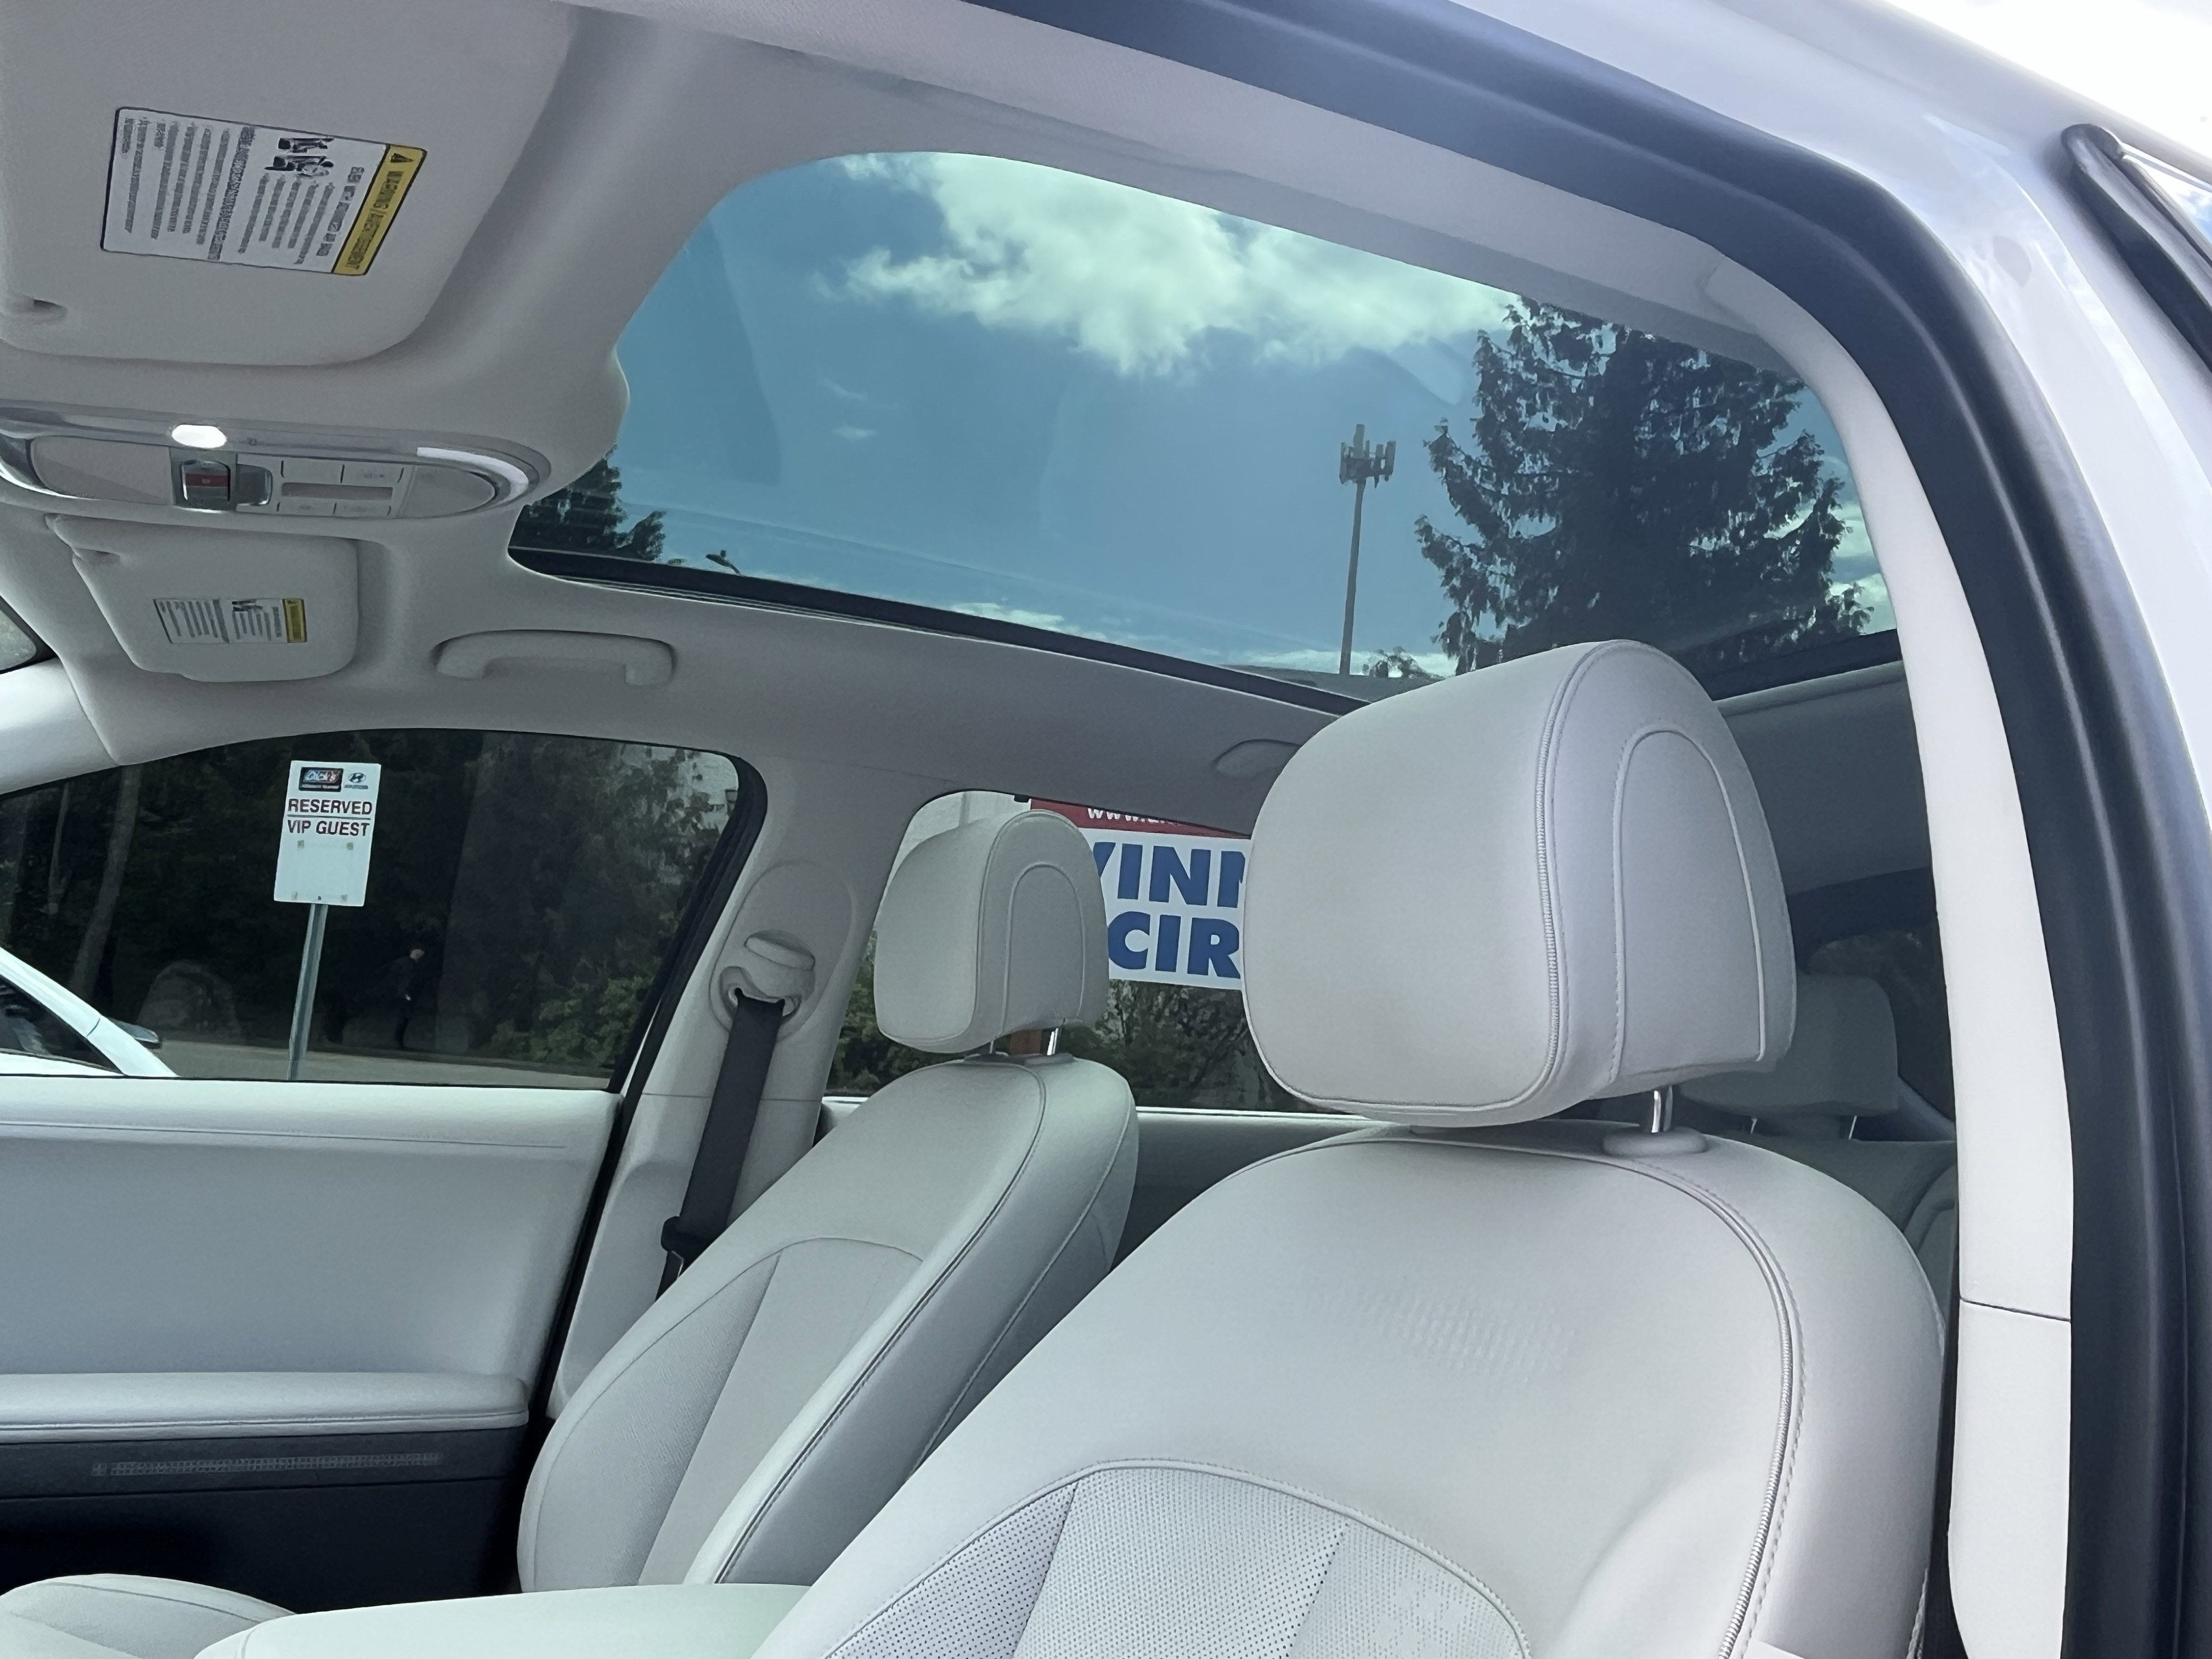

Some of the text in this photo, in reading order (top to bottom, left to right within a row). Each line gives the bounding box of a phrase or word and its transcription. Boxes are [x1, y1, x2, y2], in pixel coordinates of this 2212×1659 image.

[287, 798, 373, 815] RESERVED
[287, 820, 370, 836] VIP GUEST
